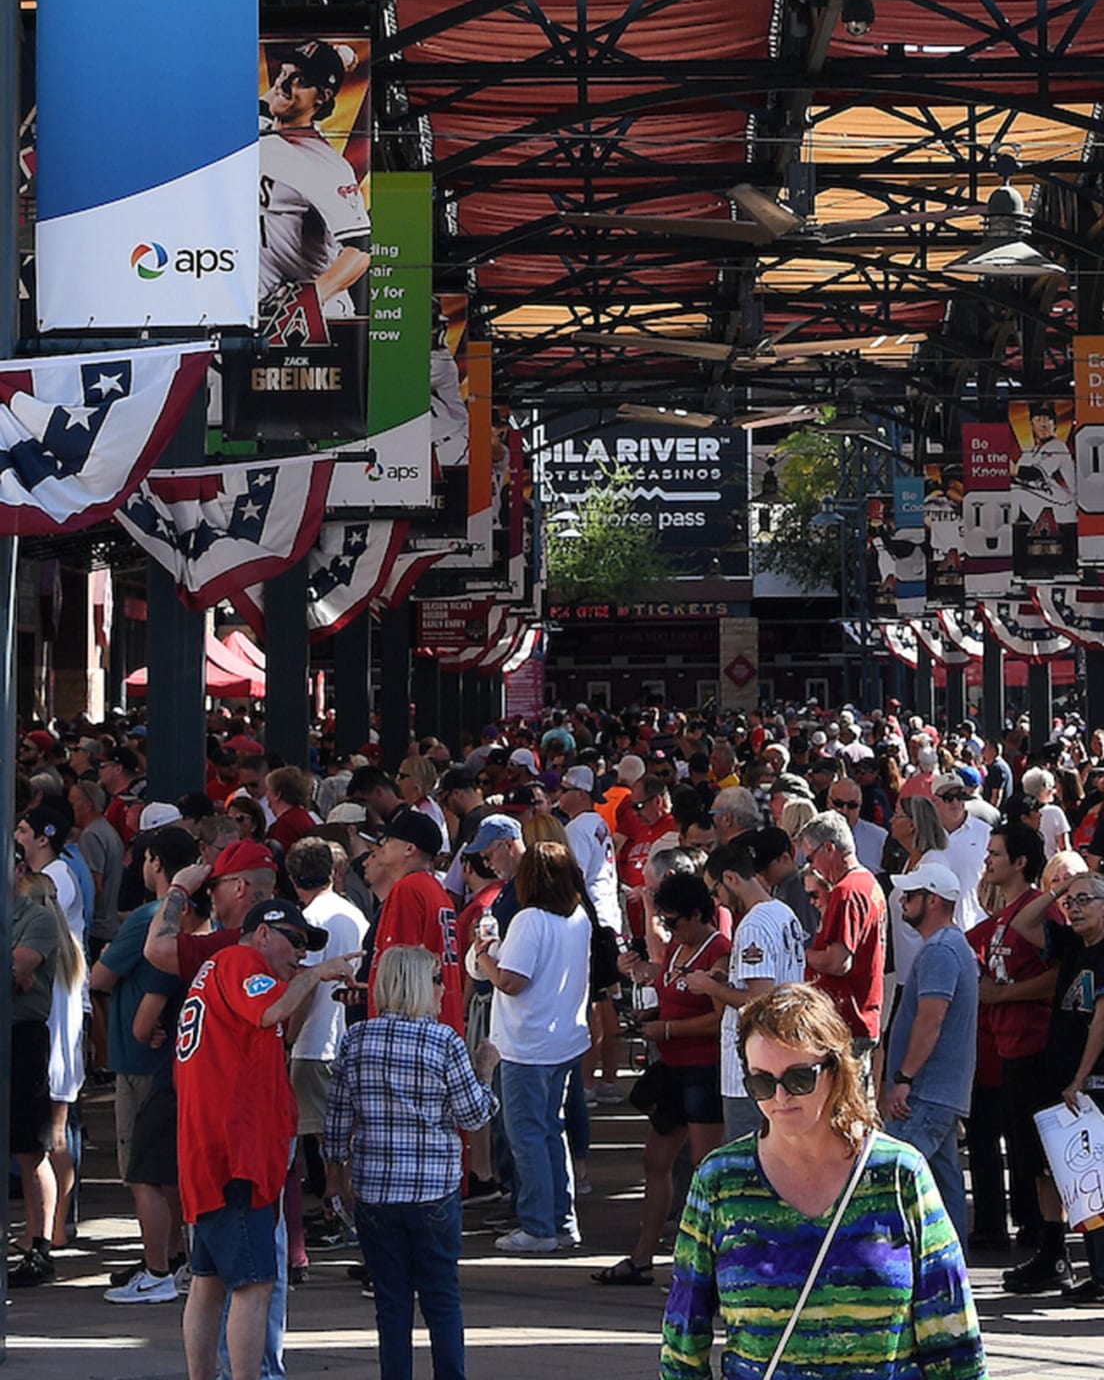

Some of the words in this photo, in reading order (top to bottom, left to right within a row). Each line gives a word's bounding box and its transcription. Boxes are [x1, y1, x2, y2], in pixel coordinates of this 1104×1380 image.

[175, 248, 236, 278] aps
[383, 286, 405, 298] for
[374, 307, 402, 319] and
[284, 356, 309, 367] ZACK
[251, 368, 342, 391] GREINKE
[616, 437, 721, 462] RIVER
[971, 438, 989, 449] Be
[971, 453, 982, 463] in
[986, 452, 1008, 463] the
[386, 464, 419, 481] aps
[541, 469, 604, 482] OTELS
[635, 468, 722, 481] CASINOS
[658, 511, 706, 530] pass
[634, 603, 728, 616] TICKETS
